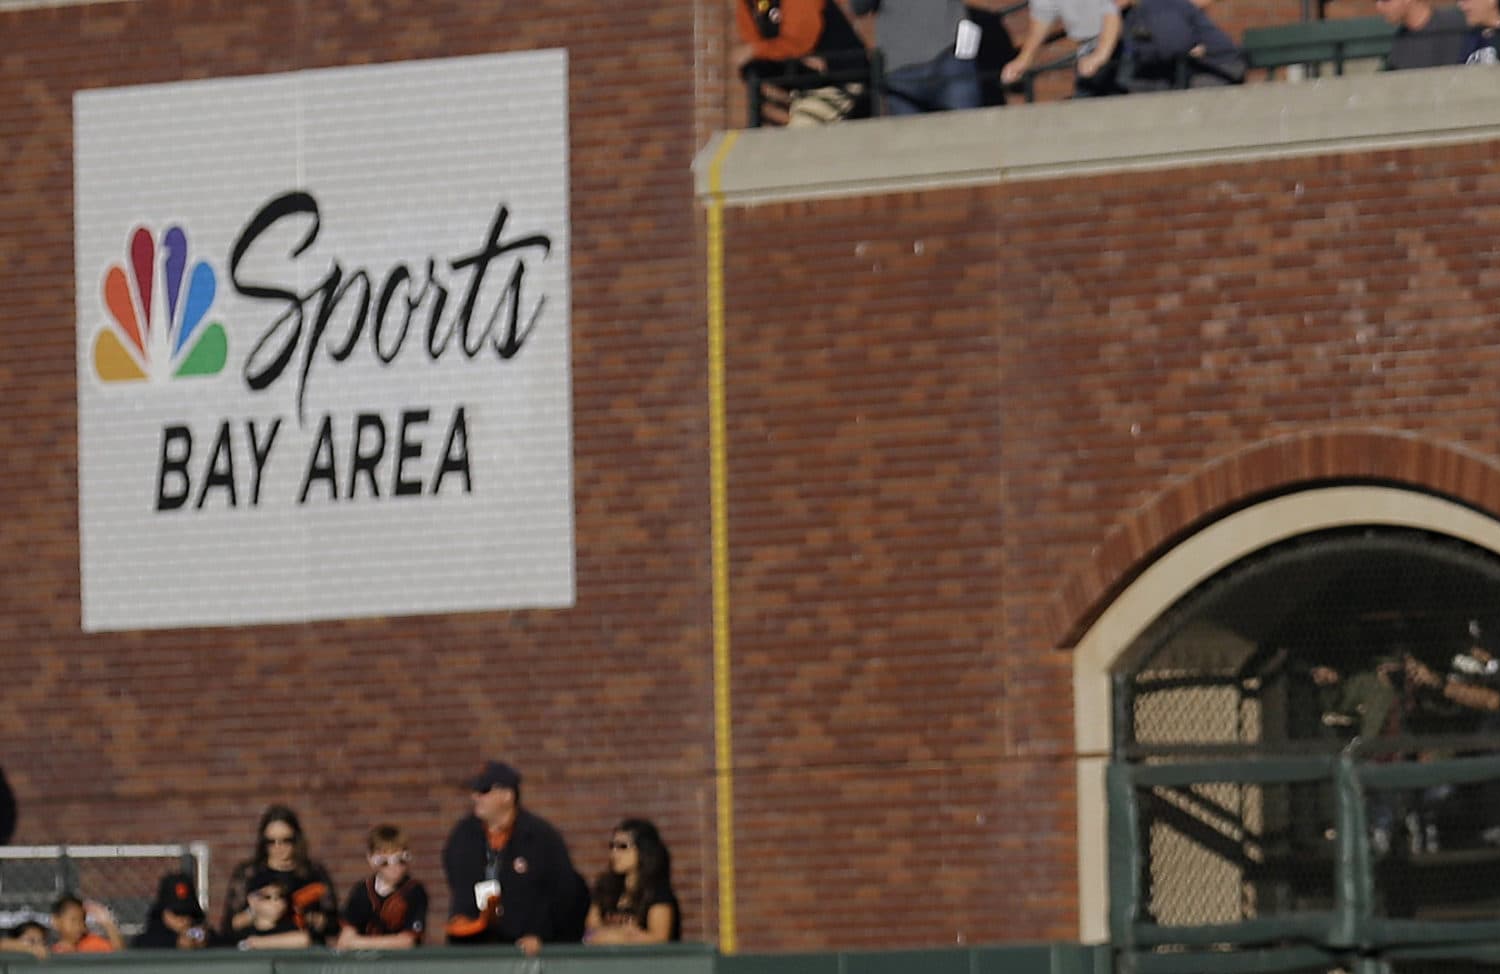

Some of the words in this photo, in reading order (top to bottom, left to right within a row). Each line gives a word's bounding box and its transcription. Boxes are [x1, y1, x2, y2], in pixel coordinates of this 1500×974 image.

[230, 191, 552, 428] Sports
[155, 418, 283, 512] BAY
[299, 406, 472, 503] AREA
